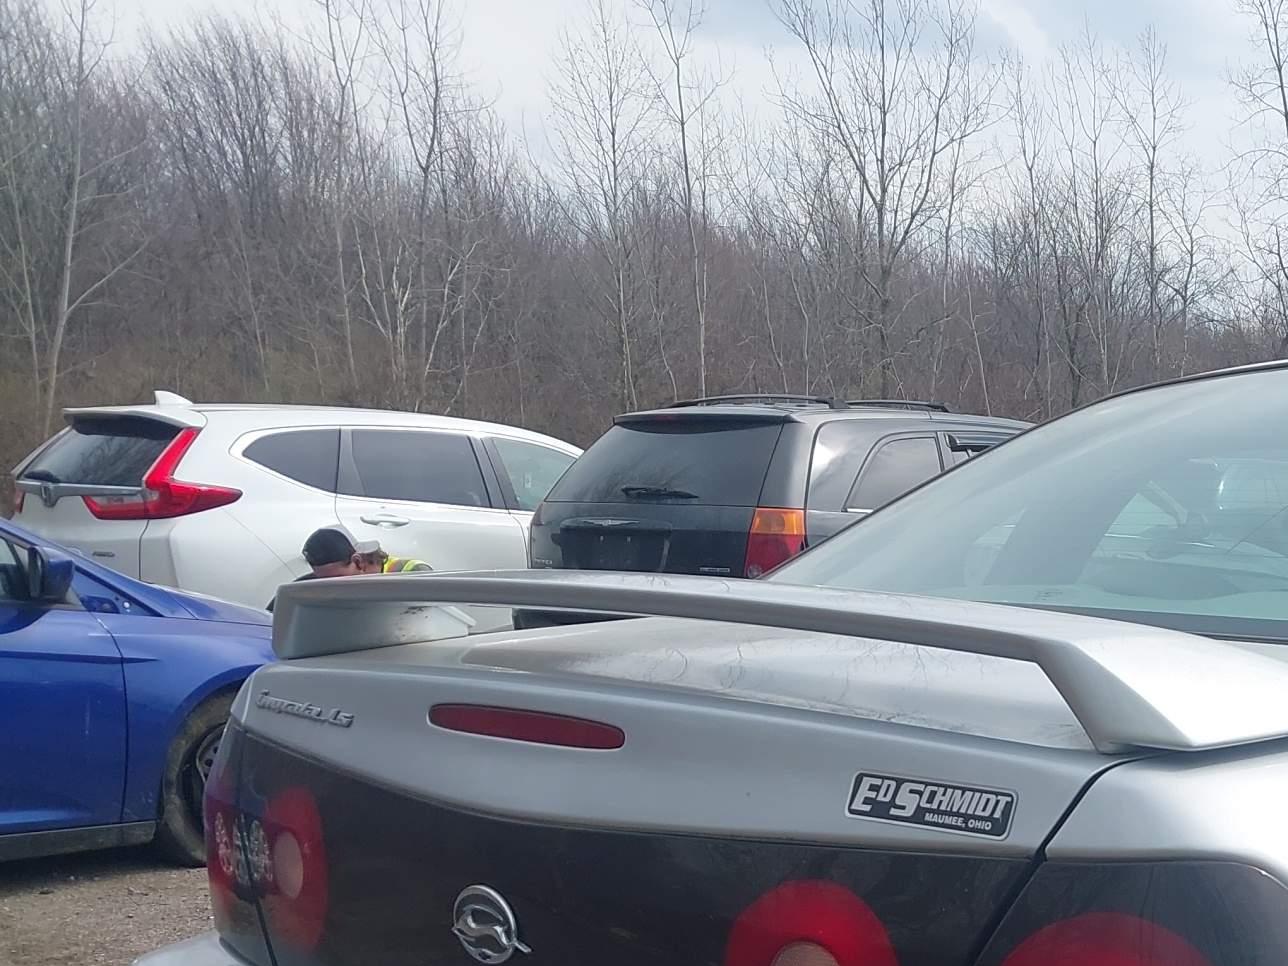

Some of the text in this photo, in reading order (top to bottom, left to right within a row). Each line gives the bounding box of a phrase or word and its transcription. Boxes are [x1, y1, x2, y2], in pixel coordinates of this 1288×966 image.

[889, 782, 1012, 818] SCHMIDT
[924, 812, 992, 831] MAUMEE, OHIO
